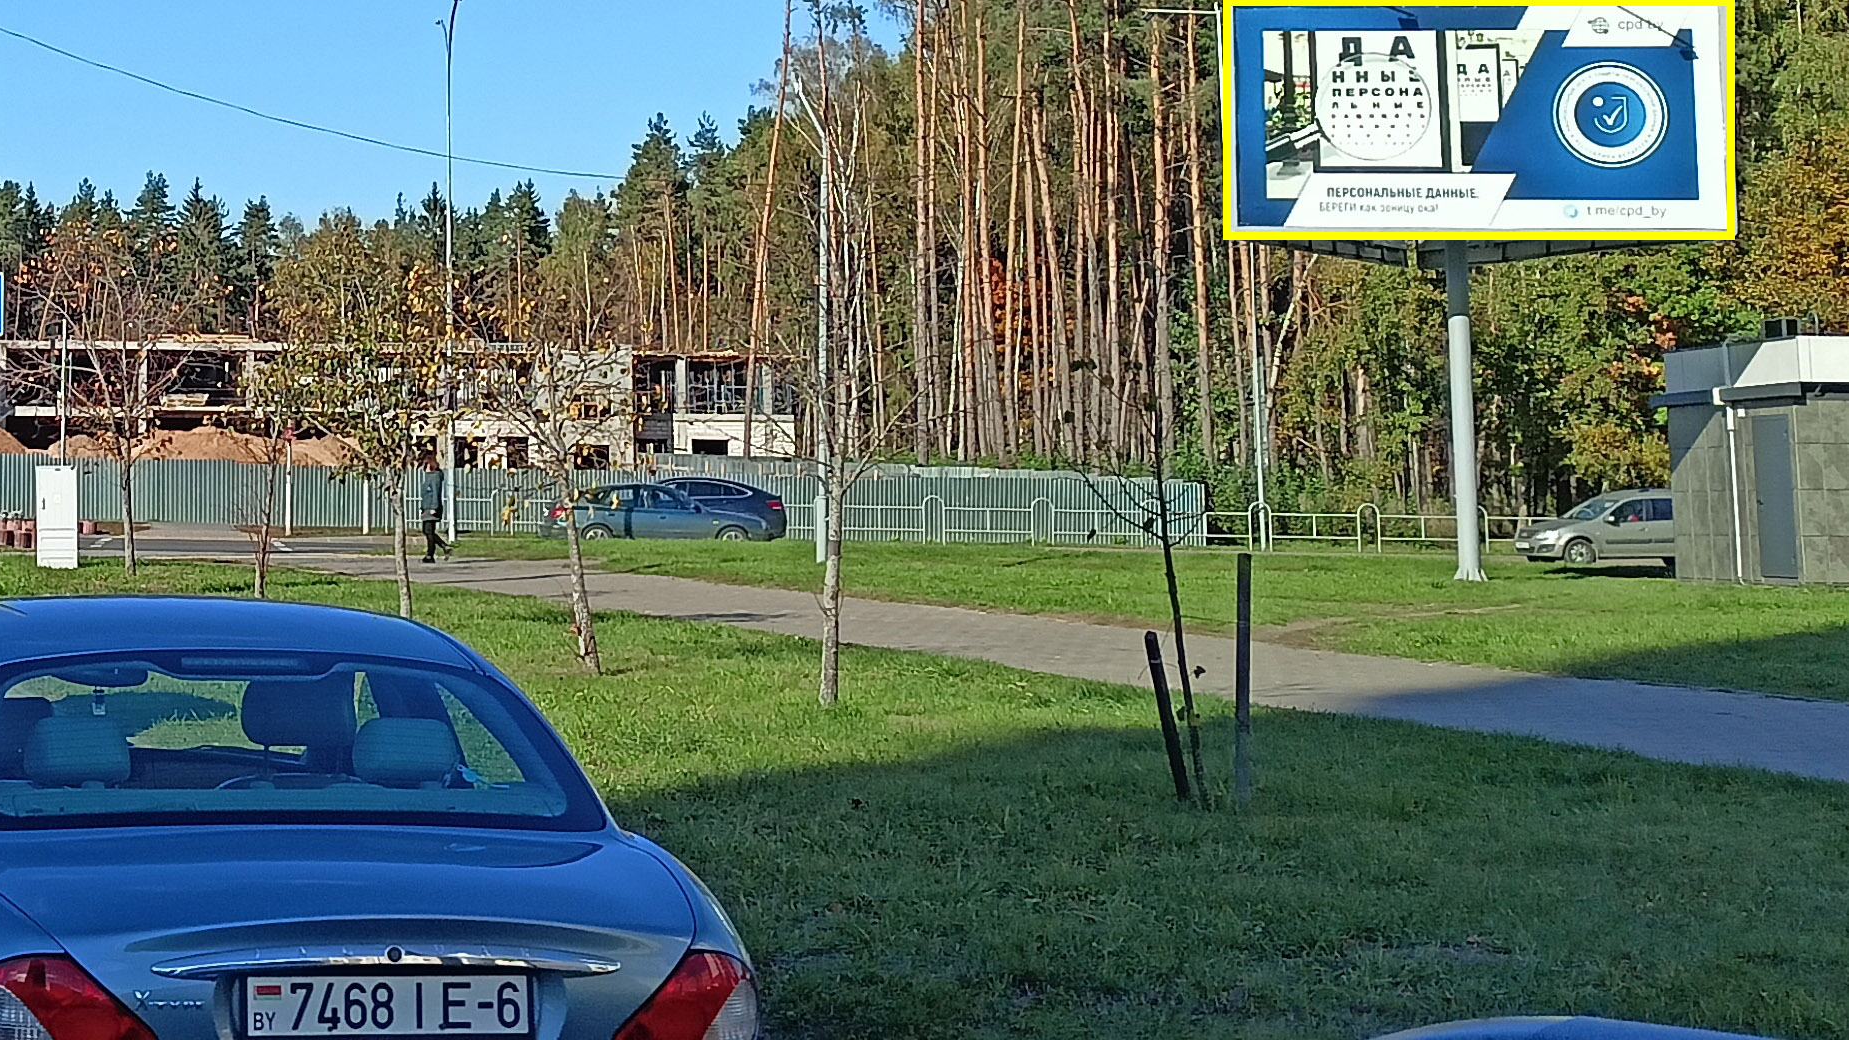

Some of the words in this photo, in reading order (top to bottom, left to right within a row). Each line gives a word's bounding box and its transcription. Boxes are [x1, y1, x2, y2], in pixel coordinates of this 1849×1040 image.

[1618, 20, 1664, 31] cpdby
[1337, 36, 1415, 66] ДА
[1332, 88, 1423, 97] ПЕРСОНА
[1326, 187, 1423, 198] ПЕРСОНАЛЬНЫЕ
[1319, 201, 1357, 212] БЕРЕГИ
[1359, 204, 1377, 212] как
[1587, 206, 1667, 218] tme/cpd_by
[290, 982, 394, 1031] 7468
[253, 1012, 276, 1031] BY
